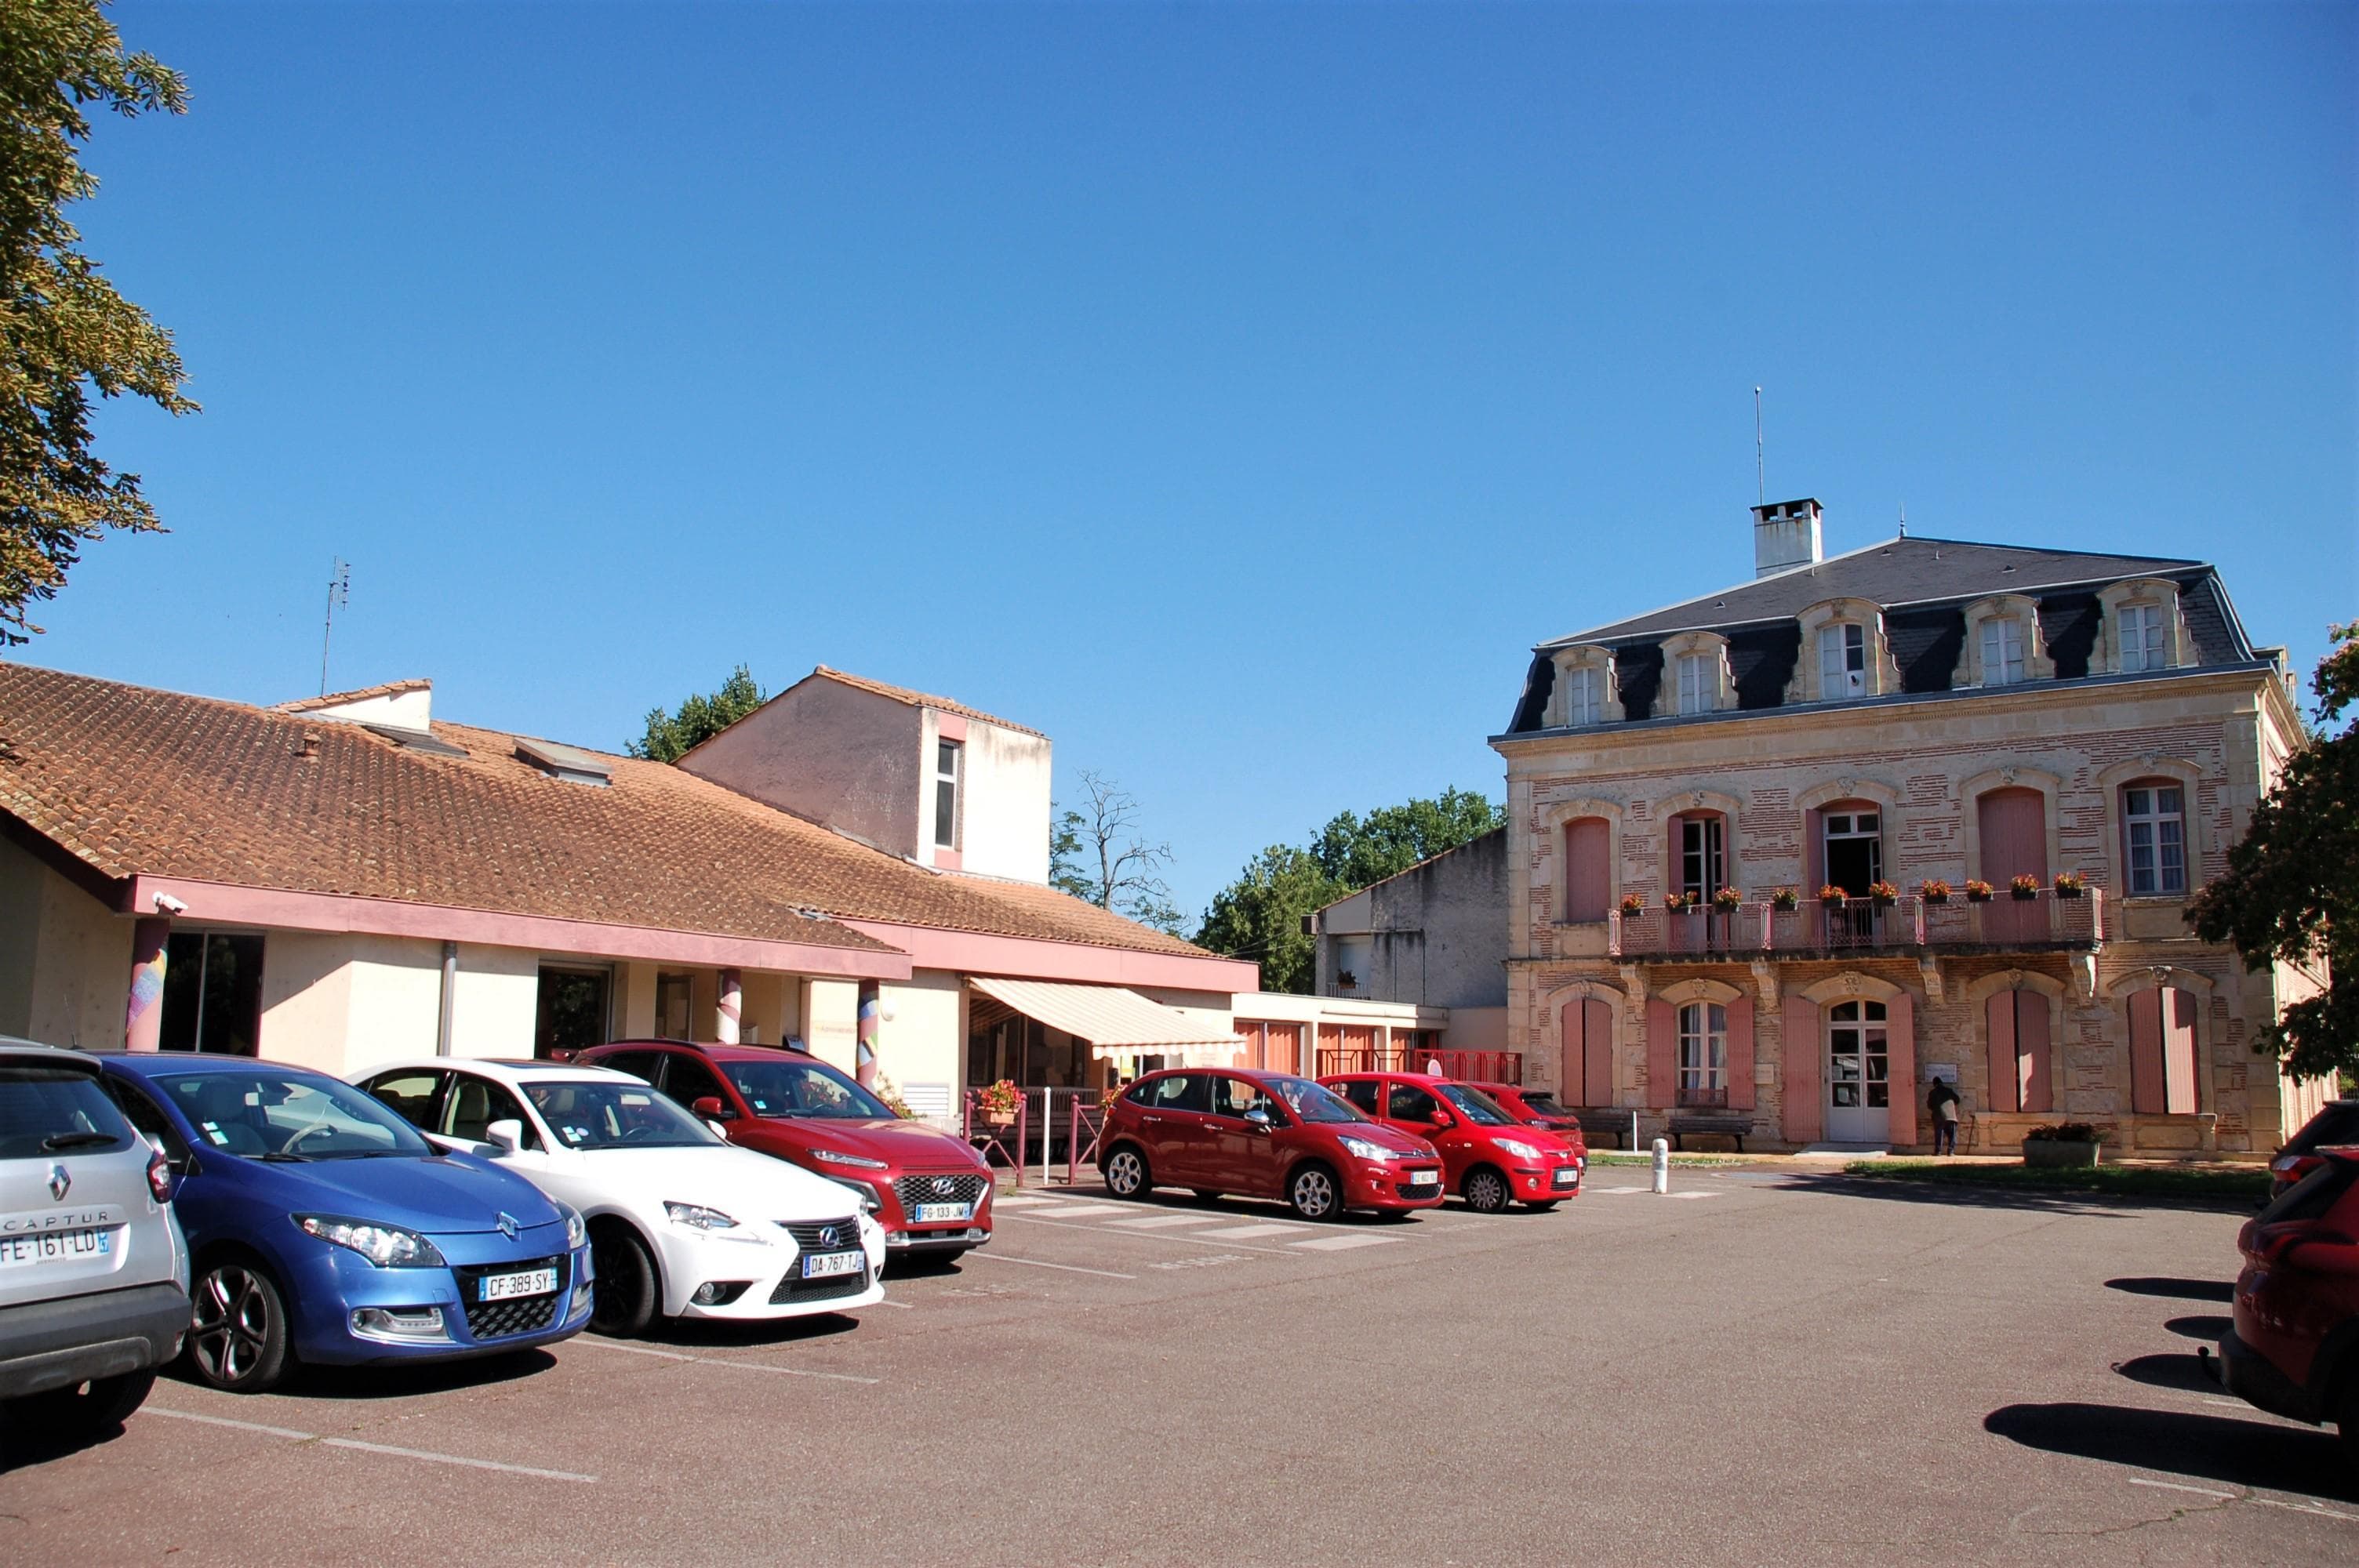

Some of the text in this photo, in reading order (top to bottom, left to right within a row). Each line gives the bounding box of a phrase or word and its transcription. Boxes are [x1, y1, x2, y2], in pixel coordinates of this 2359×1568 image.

[4, 1211, 108, 1231] CAPTUR
[0, 1229, 95, 1262] FE-161-LD
[811, 1254, 858, 1273] DA-767-TJ
[490, 1272, 548, 1296] CF-389-SY
